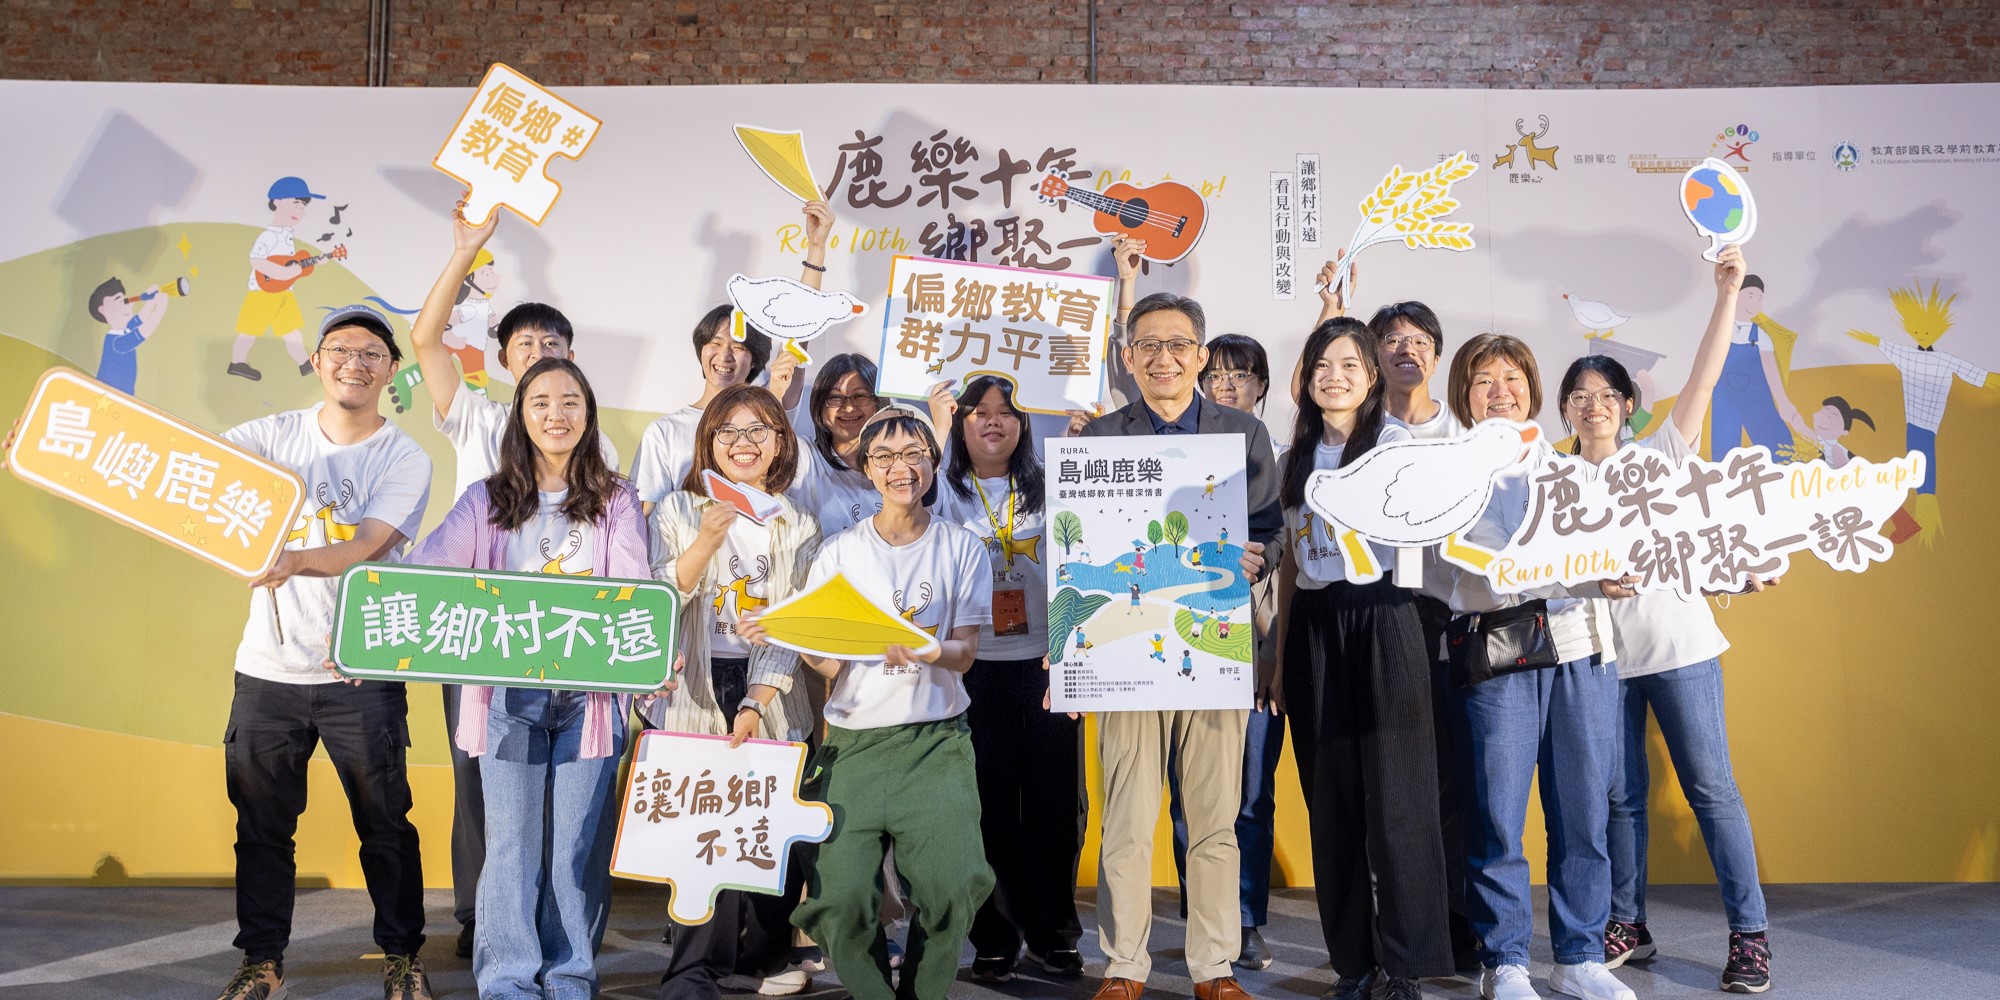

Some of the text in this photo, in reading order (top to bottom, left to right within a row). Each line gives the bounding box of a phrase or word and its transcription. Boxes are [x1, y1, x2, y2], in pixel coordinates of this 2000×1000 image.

[481, 81, 562, 144] 偏鄉
[460, 119, 539, 183] 教育
[824, 129, 1092, 213] 鹿樂十年
[1509, 172, 1530, 183] 鹿樂
[1573, 154, 1616, 164] 協辦單位
[1772, 151, 1817, 162] 指導單位
[1301, 160, 1317, 242] 讓鄉村不遠
[776, 224, 839, 254] Ruo
[850, 227, 911, 254] 10th
[1275, 179, 1291, 295] 看見行動與改變
[903, 272, 1100, 332] 偏鄉教育
[896, 317, 1091, 376] 群力平臺
[38, 399, 273, 549] 島嶼鹿樂
[1059, 458, 1163, 484] 島嶼鹿樂
[1518, 450, 1918, 546] 鹿樂十年 Meet up!
[1308, 546, 1328, 561] 鹿樂
[1491, 506, 1885, 595] Ruro 10th 鄉聚一課
[361, 590, 662, 667] 讓鄉村不遠
[634, 768, 777, 823] 讓偏鄉
[696, 816, 776, 870] 不遠
